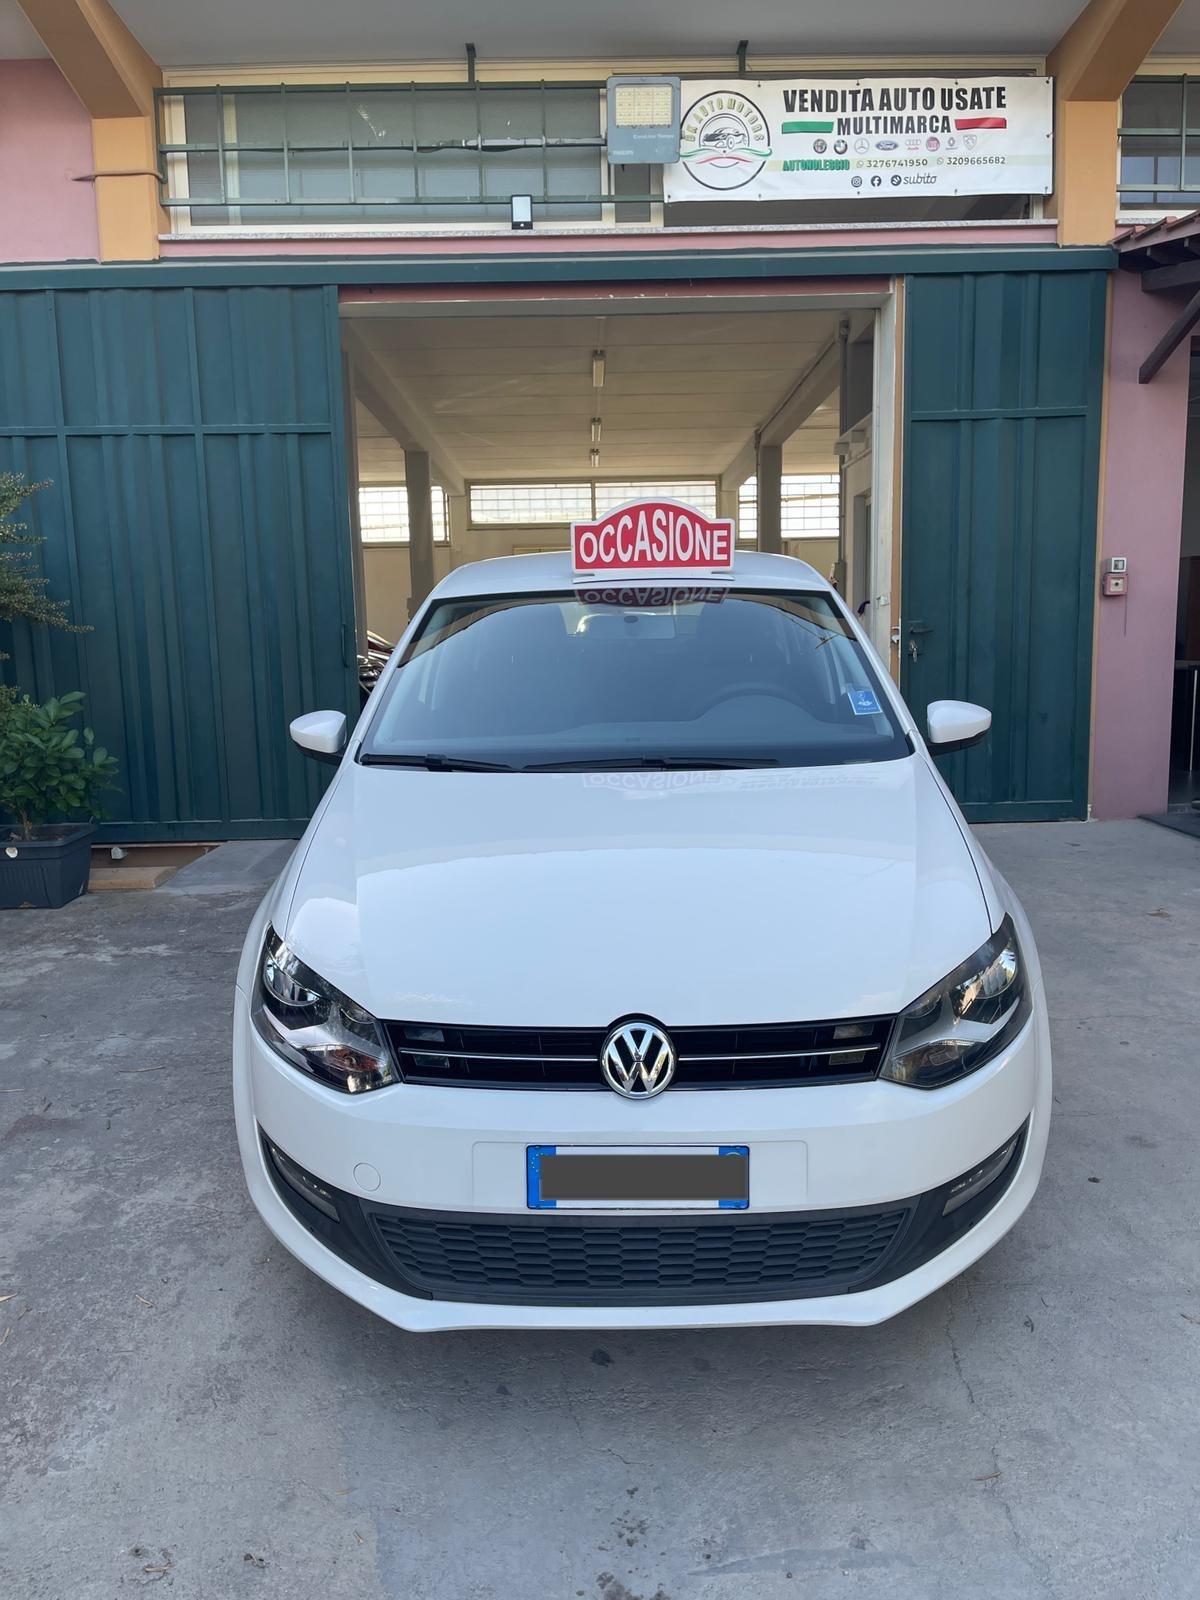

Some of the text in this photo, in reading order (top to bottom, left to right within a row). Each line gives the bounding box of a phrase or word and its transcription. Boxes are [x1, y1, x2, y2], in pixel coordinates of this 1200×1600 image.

[783, 86, 1007, 113] VENDITA AUTO USATE
[837, 115, 951, 135] MULTIMARCA
[782, 159, 850, 171] AUTONOLEGGIO
[867, 158, 928, 168] 3276741950
[947, 156, 1006, 165] 3209665682
[903, 172, 937, 185] subito
[579, 508, 728, 563] OCCASIONE
